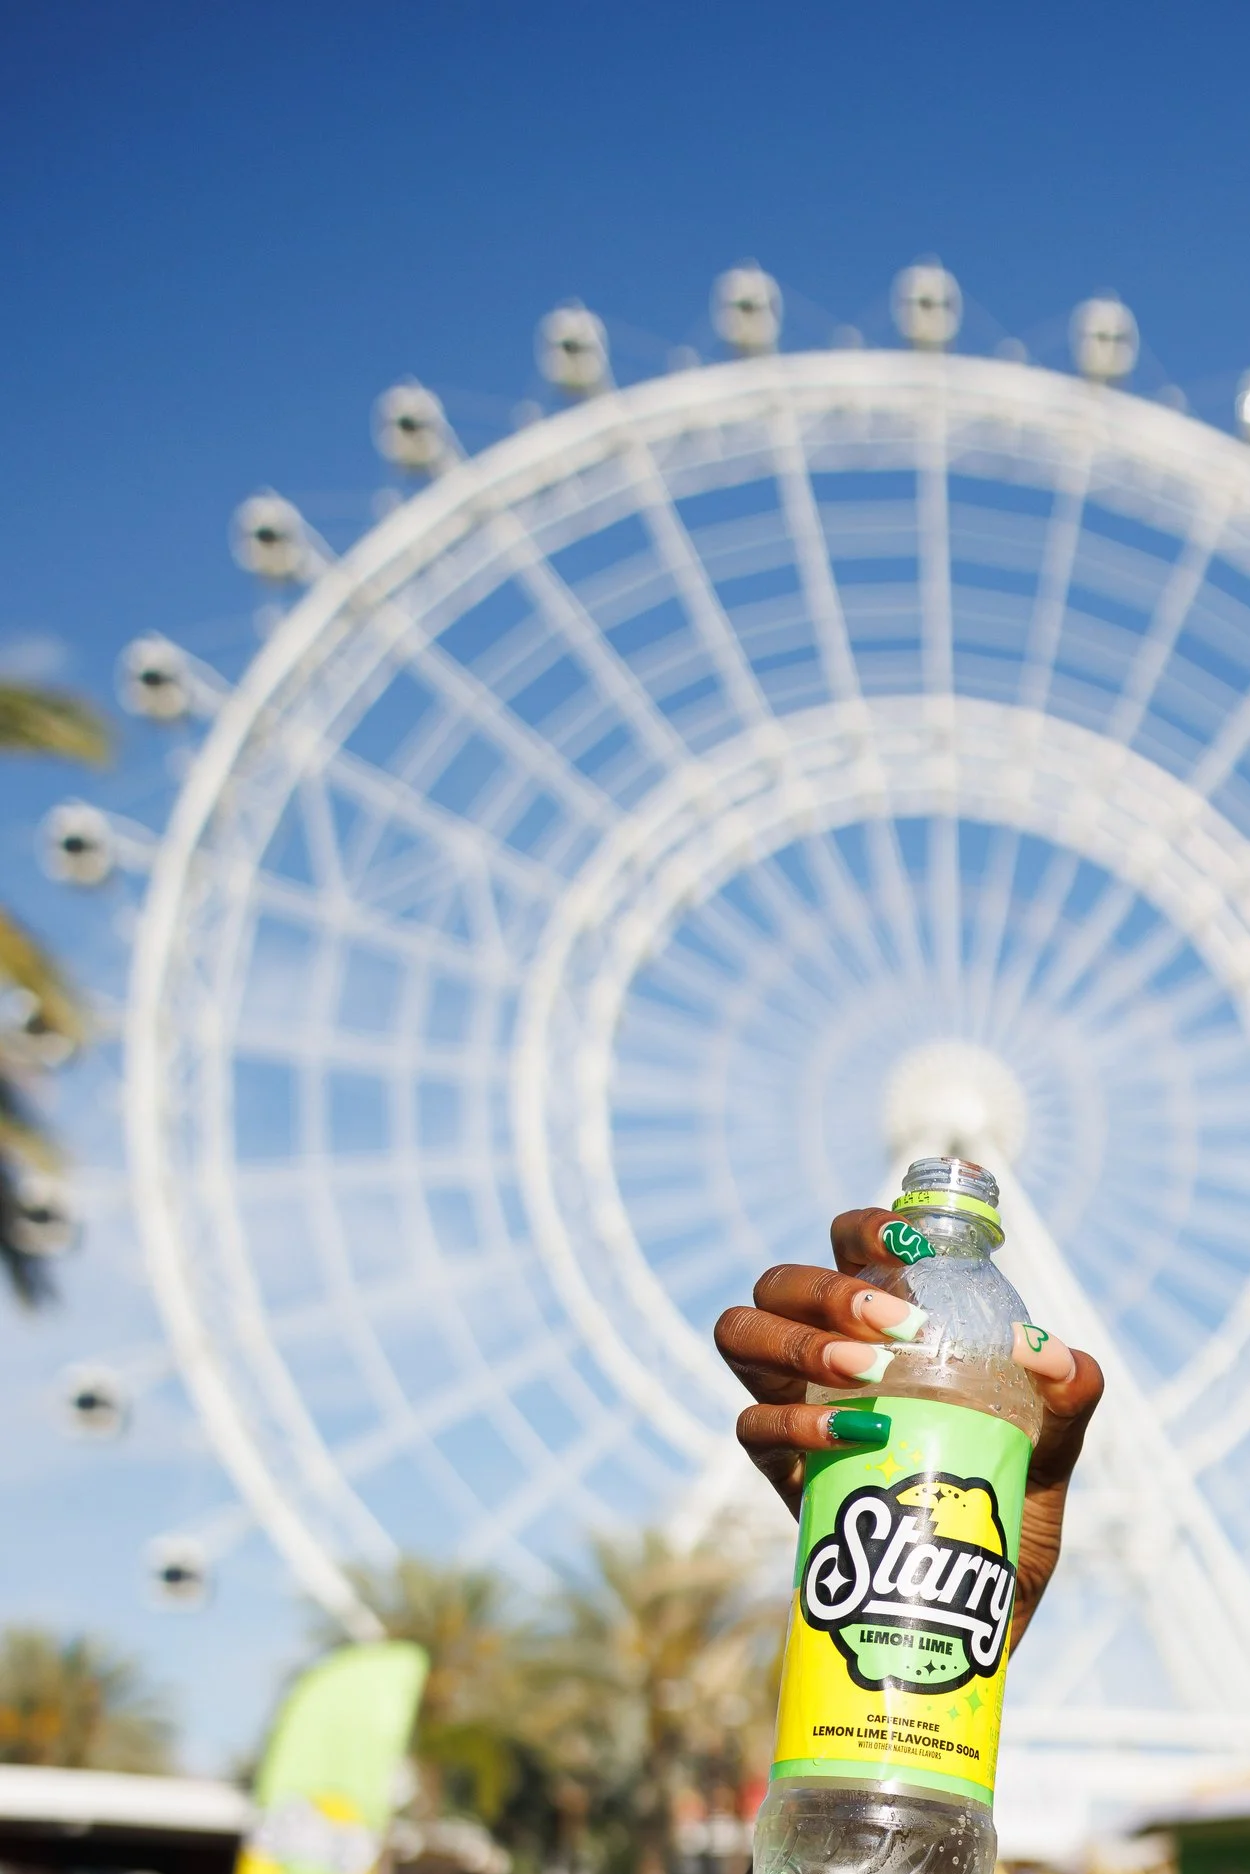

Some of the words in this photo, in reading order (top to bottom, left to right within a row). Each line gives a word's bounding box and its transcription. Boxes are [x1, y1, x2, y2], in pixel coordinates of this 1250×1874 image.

[806, 1496, 1015, 1667] Starry
[859, 1629, 914, 1649] LEMON
[918, 1636, 954, 1656] LIME
[867, 1714, 915, 1728] CAFFEINE
[917, 1721, 940, 1733] FREE
[813, 1726, 854, 1737] LEMON
[857, 1728, 888, 1740] LIME
[891, 1731, 955, 1752] FLAVORED
[956, 1744, 980, 1761] SODA
[858, 1741, 873, 1750] WITH
[874, 1742, 892, 1751] OTHER
[893, 1744, 918, 1756] NATURAL
[919, 1749, 942, 1760] FLAVORS
